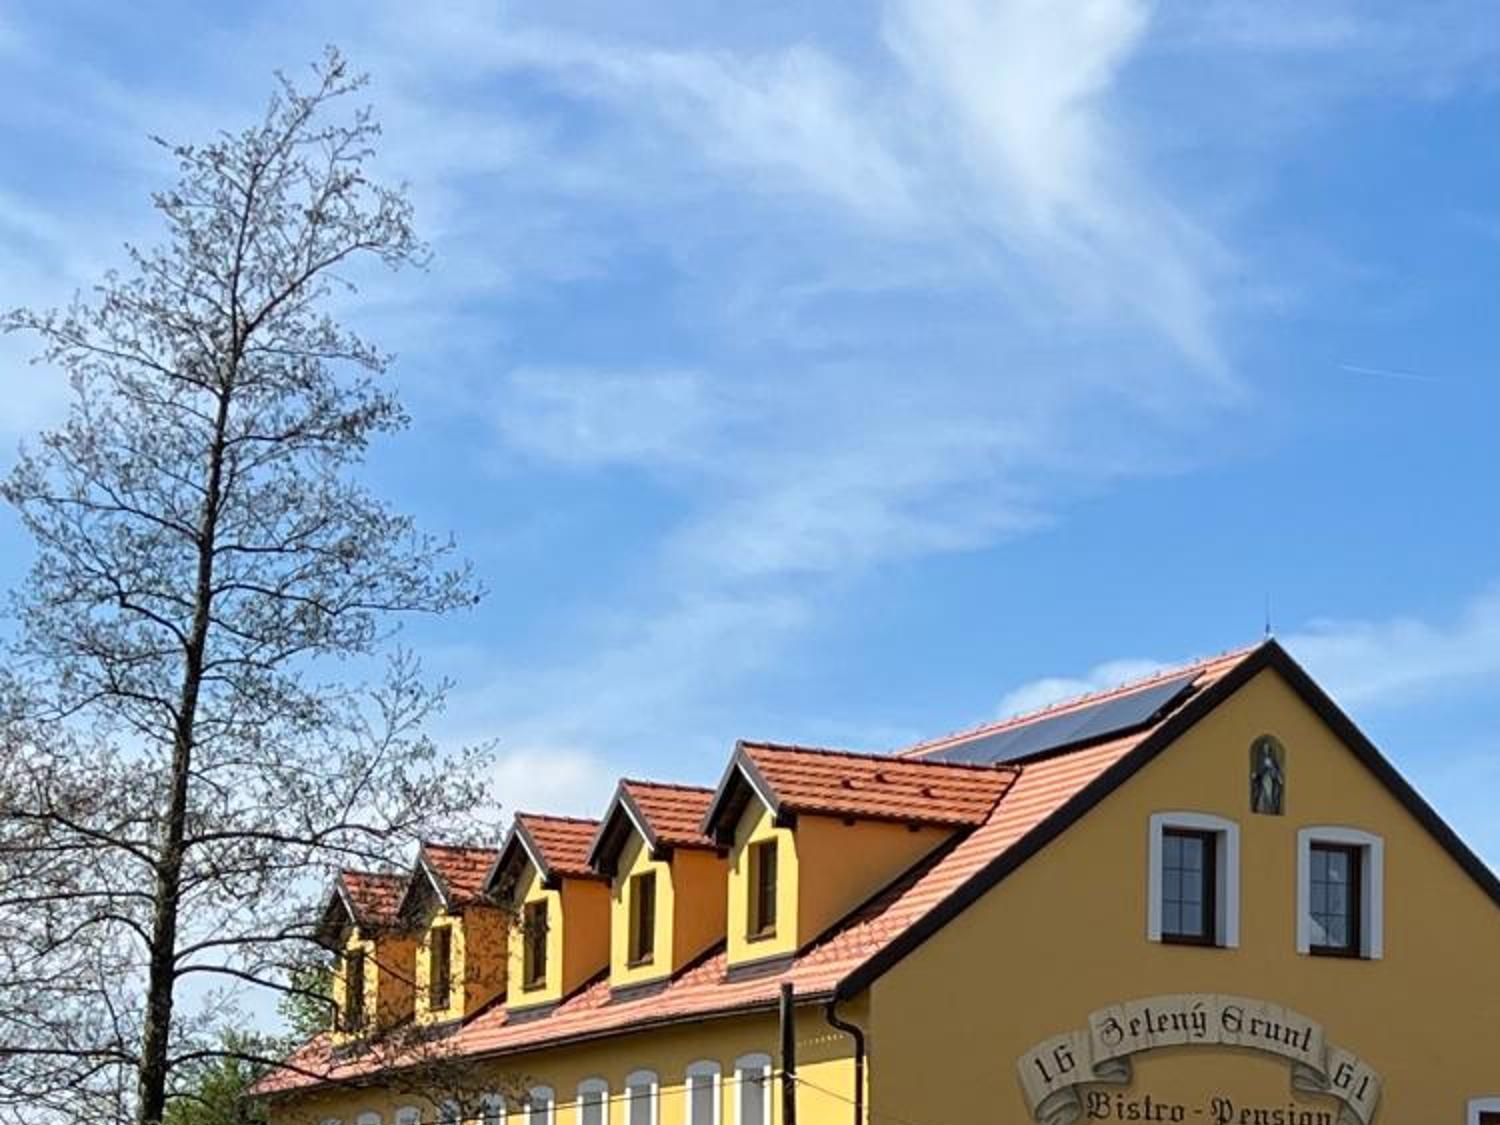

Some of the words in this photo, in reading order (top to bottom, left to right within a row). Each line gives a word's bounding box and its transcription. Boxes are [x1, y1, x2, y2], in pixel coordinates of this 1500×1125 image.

[1034, 1044, 1075, 1084] 16
[1101, 1002, 1207, 1046] Zelený
[1221, 1005, 1312, 1053] Grunt
[1333, 1063, 1369, 1101] 61
[1086, 1091, 1185, 1123] Bistro
